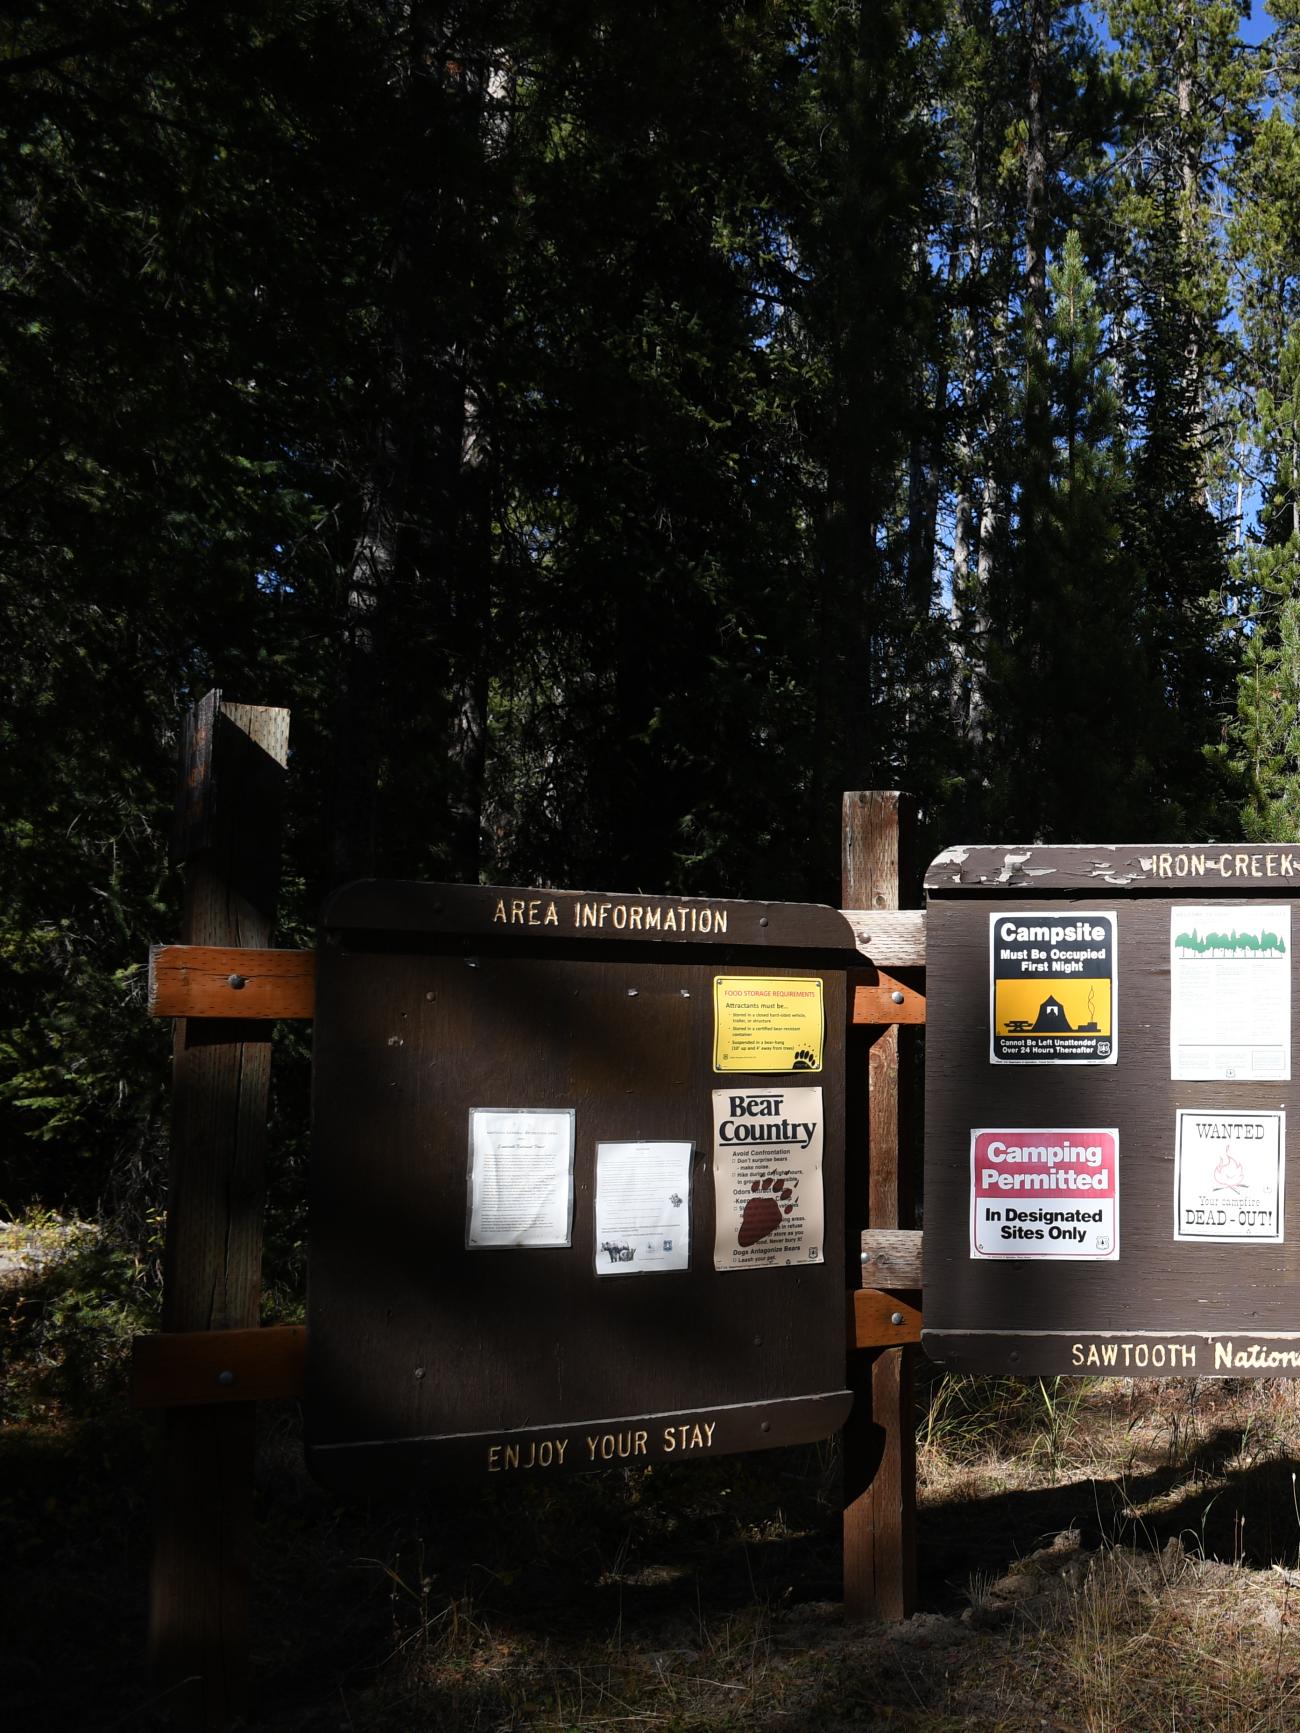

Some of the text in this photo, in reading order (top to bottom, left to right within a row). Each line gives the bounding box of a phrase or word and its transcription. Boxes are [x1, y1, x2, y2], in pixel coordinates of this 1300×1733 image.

[1152, 853, 1204, 876] IRON
[1220, 853, 1294, 876] CREEK
[493, 899, 728, 933] AREA INFORMATION
[1000, 922, 1106, 944] Campsite
[1000, 948, 1106, 960] Must Be Occupied
[1022, 961, 1084, 973] First Night
[729, 1096, 783, 1117] Bear
[719, 1119, 817, 1149] Country
[1196, 1124, 1264, 1140] WANTED
[988, 1141, 1102, 1166] Camping
[982, 1168, 1108, 1189] Permitted
[1198, 1196, 1260, 1209] Your campfire
[986, 1208, 1102, 1225] In Designated
[1000, 1226, 1087, 1243] Sites Only
[1072, 1344, 1196, 1367] SAWTOOTH
[488, 1422, 715, 1472] ENJOY YOUR STAY
